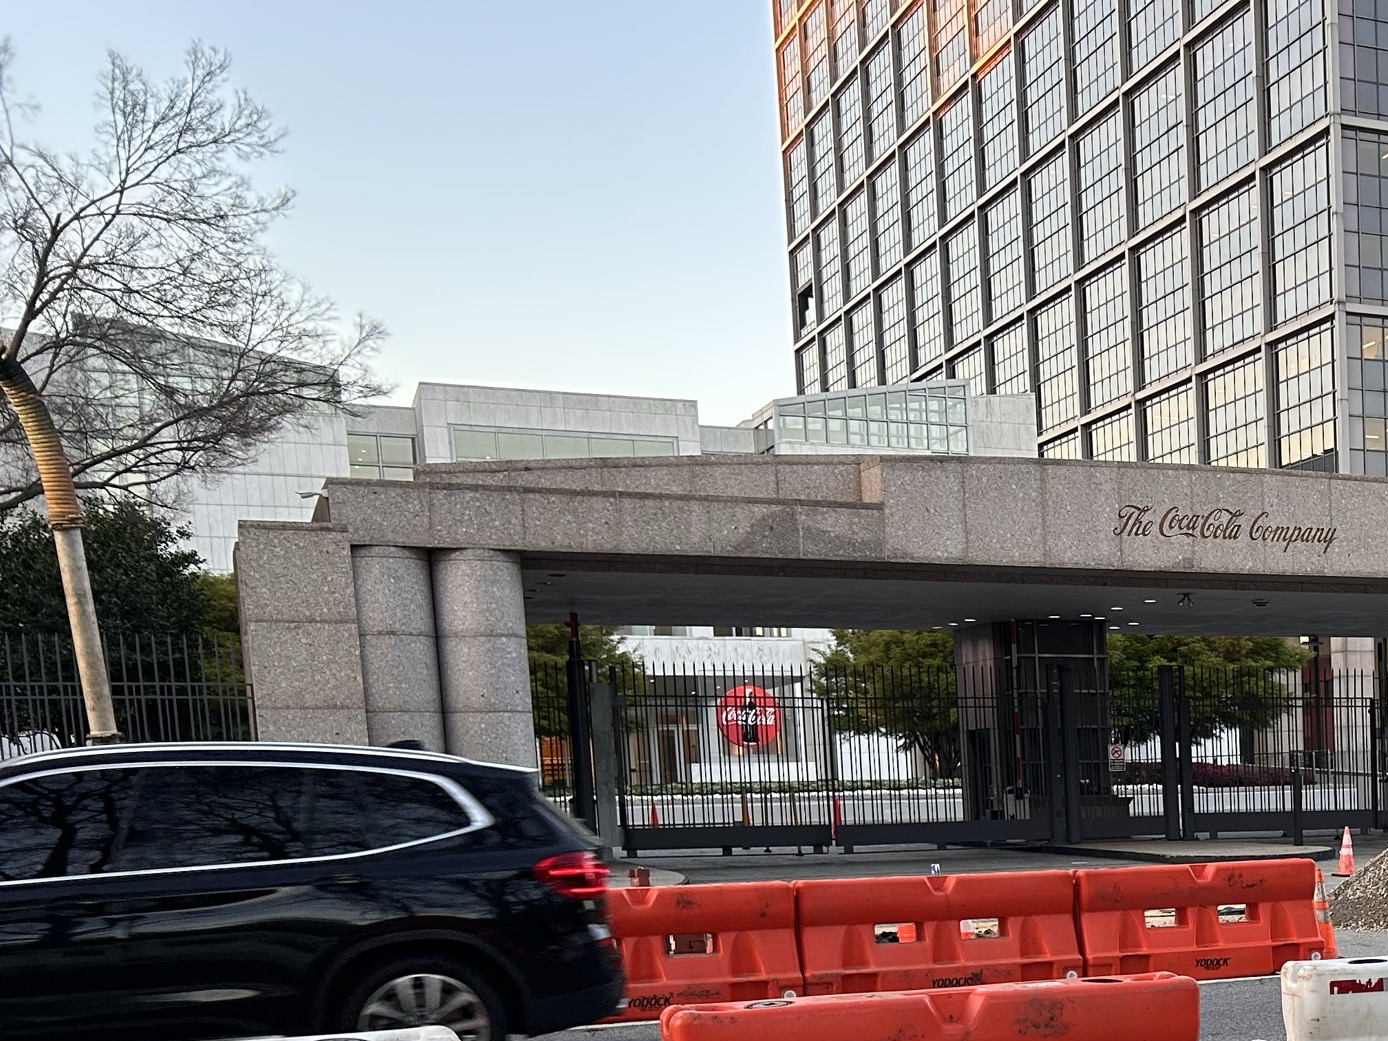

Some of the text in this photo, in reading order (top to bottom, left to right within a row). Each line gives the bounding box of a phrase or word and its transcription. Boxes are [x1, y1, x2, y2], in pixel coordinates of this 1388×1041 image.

[1113, 504, 1153, 537] The
[1249, 511, 1337, 554] Company
[1195, 957, 1230, 968] YODOCK
[931, 976, 972, 989] YODOCK
